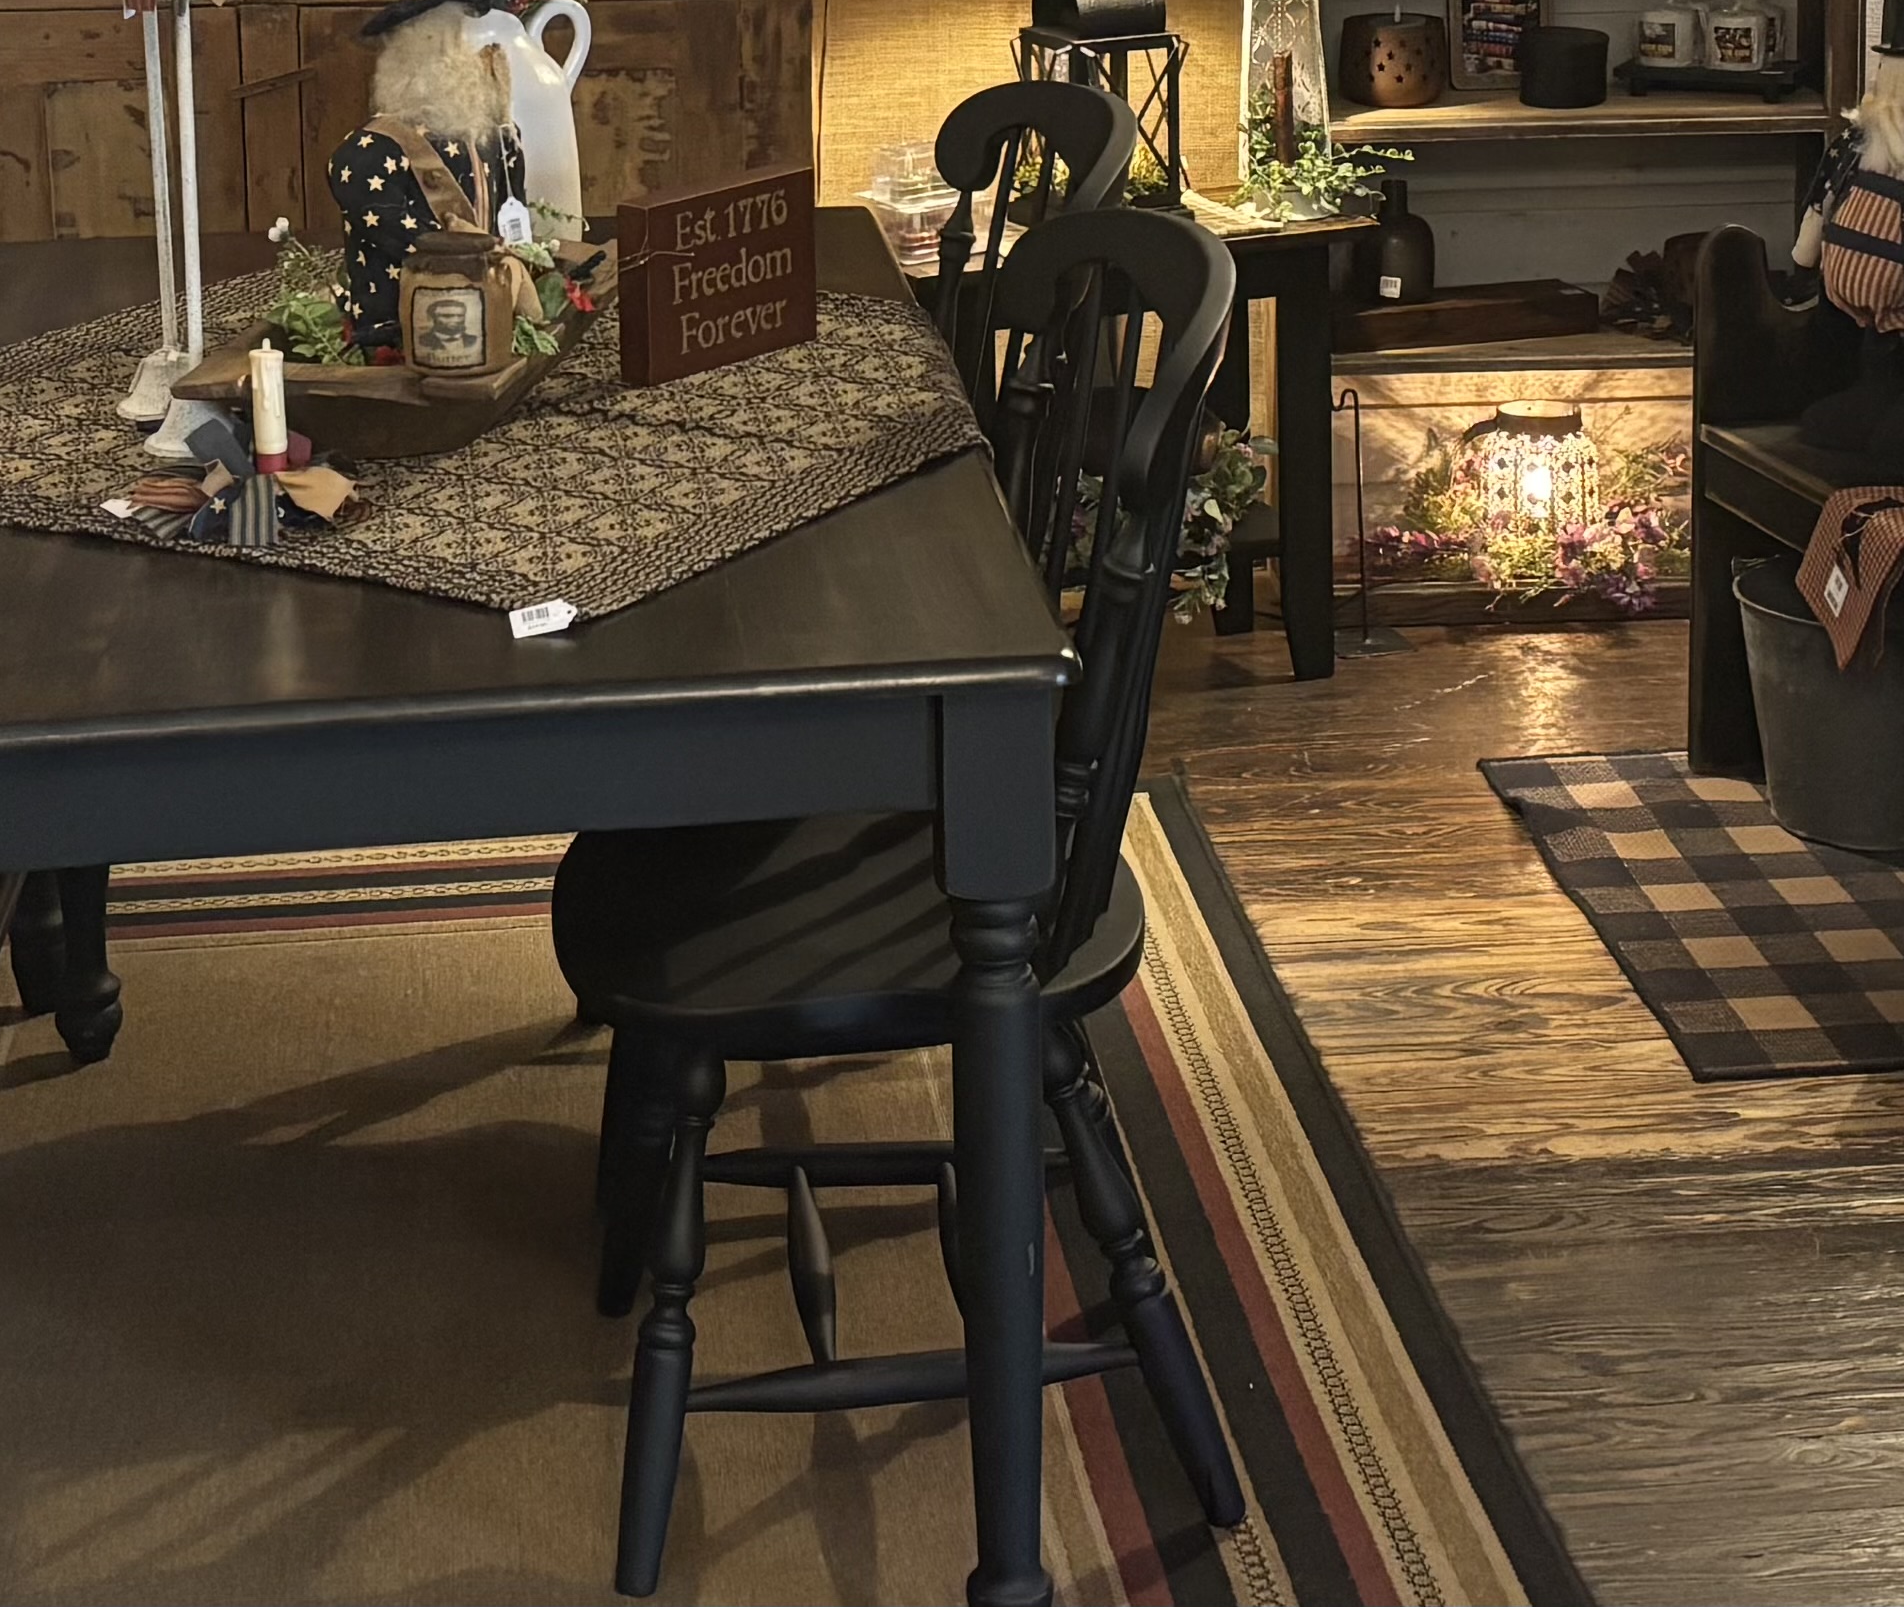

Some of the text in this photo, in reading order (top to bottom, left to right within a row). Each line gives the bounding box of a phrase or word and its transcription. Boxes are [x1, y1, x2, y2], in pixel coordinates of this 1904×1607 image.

[675, 188, 788, 251] Est. 1776
[672, 247, 793, 305] Freedom
[680, 299, 787, 355] Forever
